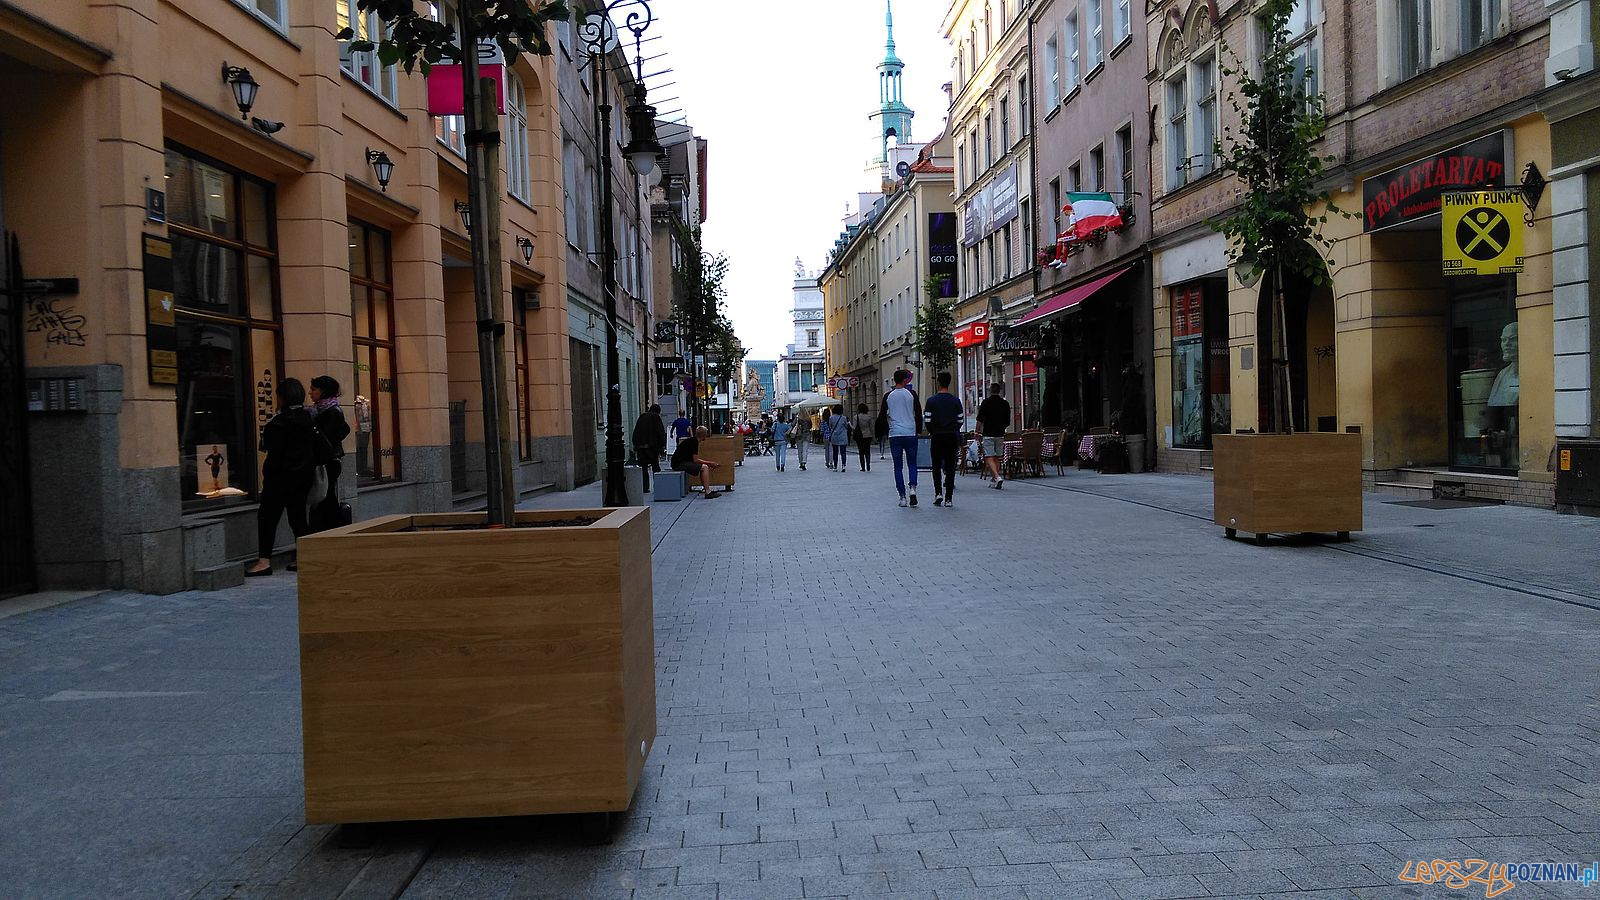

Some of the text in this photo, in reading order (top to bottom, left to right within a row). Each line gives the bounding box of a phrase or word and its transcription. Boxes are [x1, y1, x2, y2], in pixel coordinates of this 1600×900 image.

[1365, 155, 1503, 229] PROLETARYAT
[1445, 192, 1521, 206] PIWNY PUNKT
[931, 255, 956, 263] GO GO
